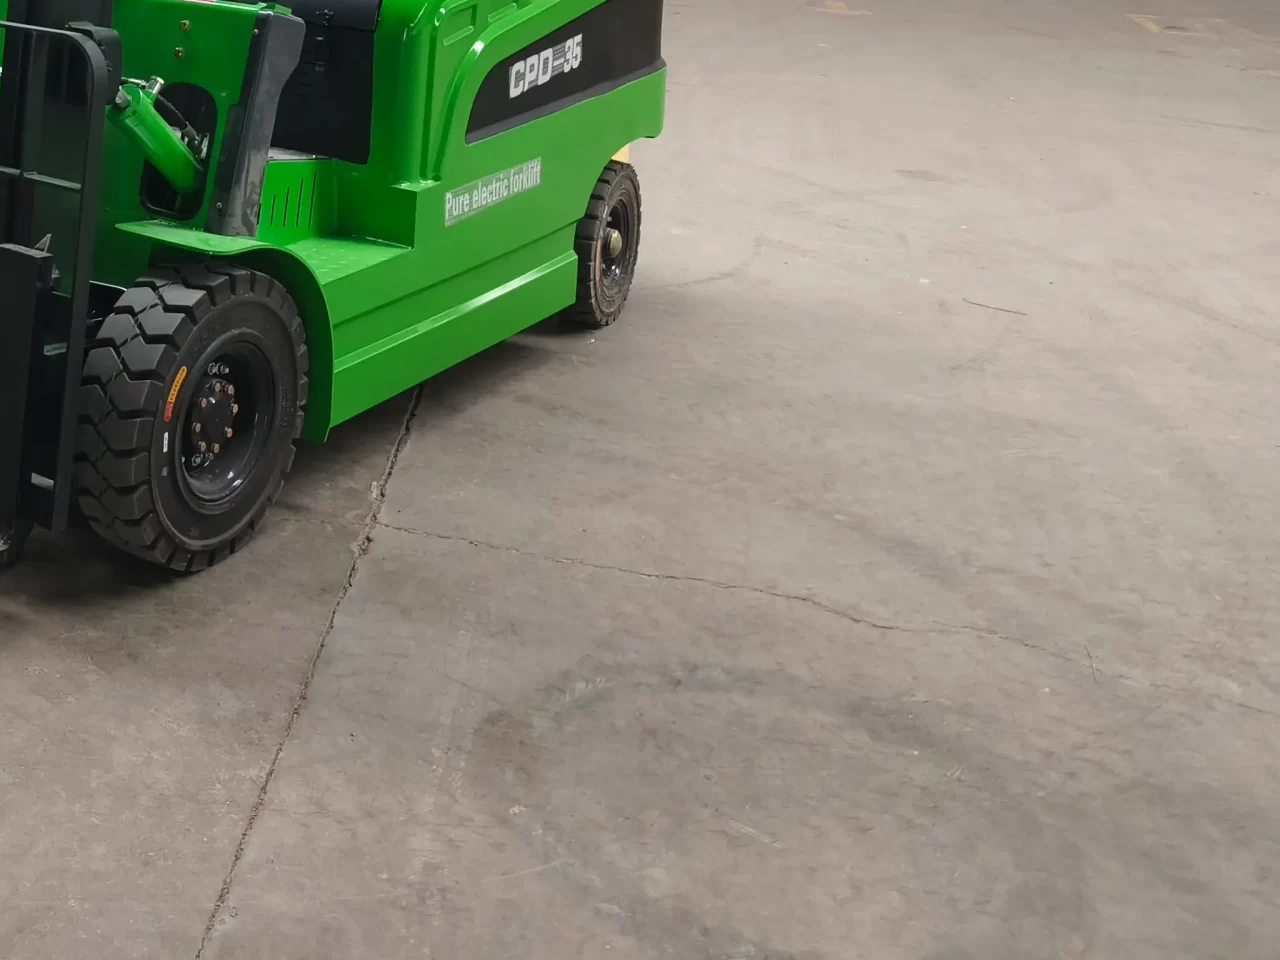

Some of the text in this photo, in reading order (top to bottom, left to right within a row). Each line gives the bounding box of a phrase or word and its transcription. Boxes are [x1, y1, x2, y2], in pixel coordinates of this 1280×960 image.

[509, 33, 583, 98] CPD-35
[445, 159, 541, 221] Pure electric forklift
